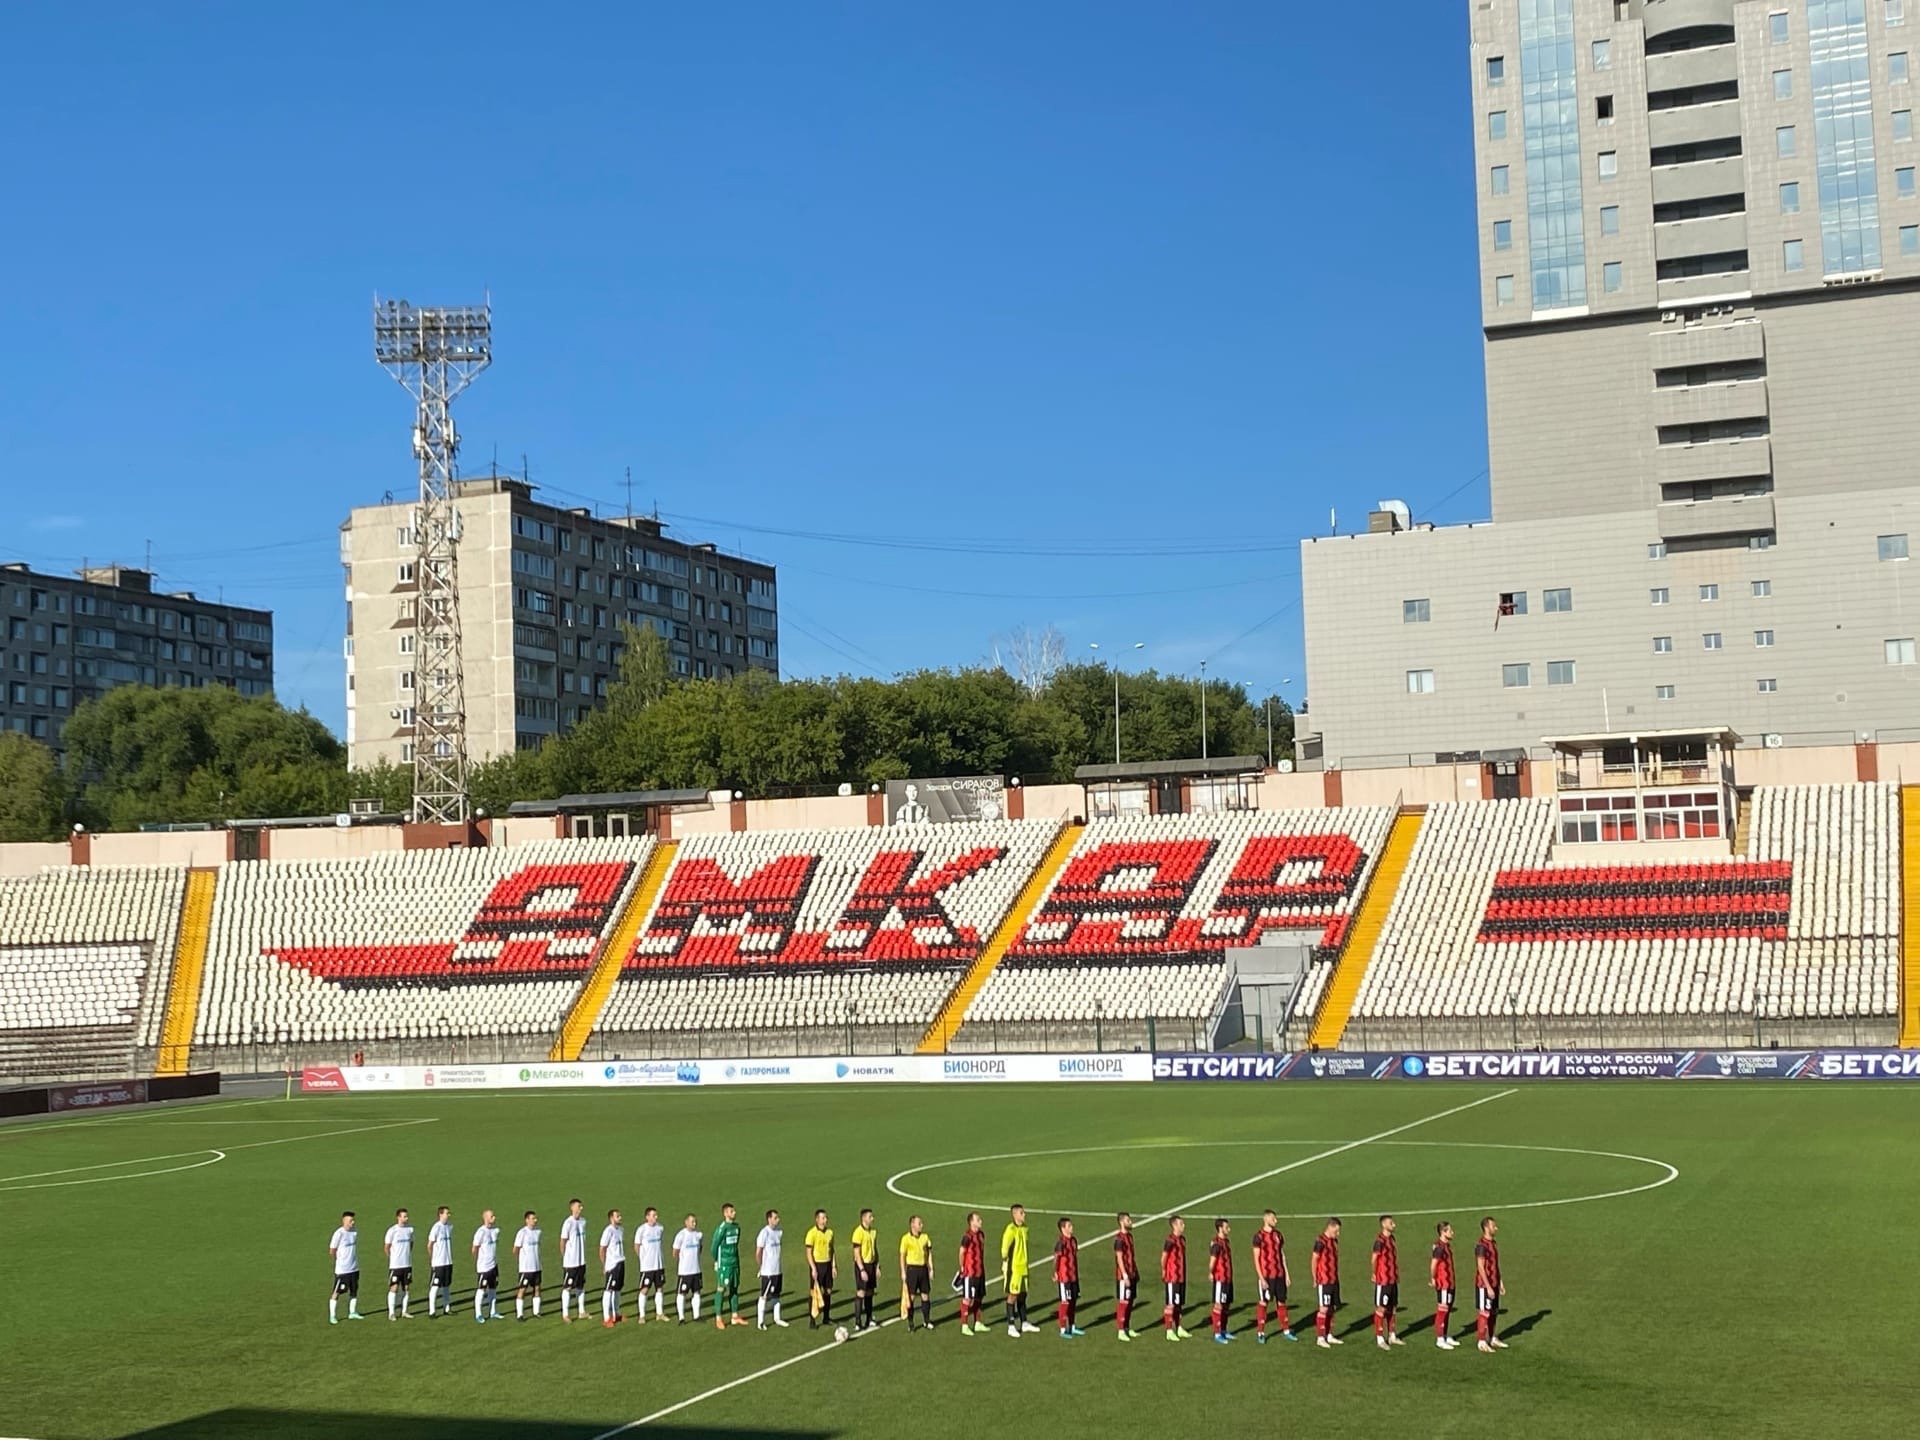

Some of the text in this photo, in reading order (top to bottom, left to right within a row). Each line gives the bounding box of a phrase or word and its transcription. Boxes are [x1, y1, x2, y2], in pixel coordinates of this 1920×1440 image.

[952, 778, 999, 792] СИРАКОВ
[1059, 1058, 1123, 1073] БИОНОРД
[1425, 1055, 1560, 1076] БЕТСИТИ
[1566, 1055, 1674, 1065] КУБОК РОССИИ
[741, 1066, 790, 1076] ГАЗПРОМБАНК
[853, 1067, 894, 1075] НОВАТЭК
[944, 1060, 1006, 1073] БИОНОРД
[1153, 1058, 1275, 1078] БЕТСИТИ
[1566, 1066, 1658, 1076] ПО ФУТБОЛУ
[307, 1080, 339, 1088] VERRA
